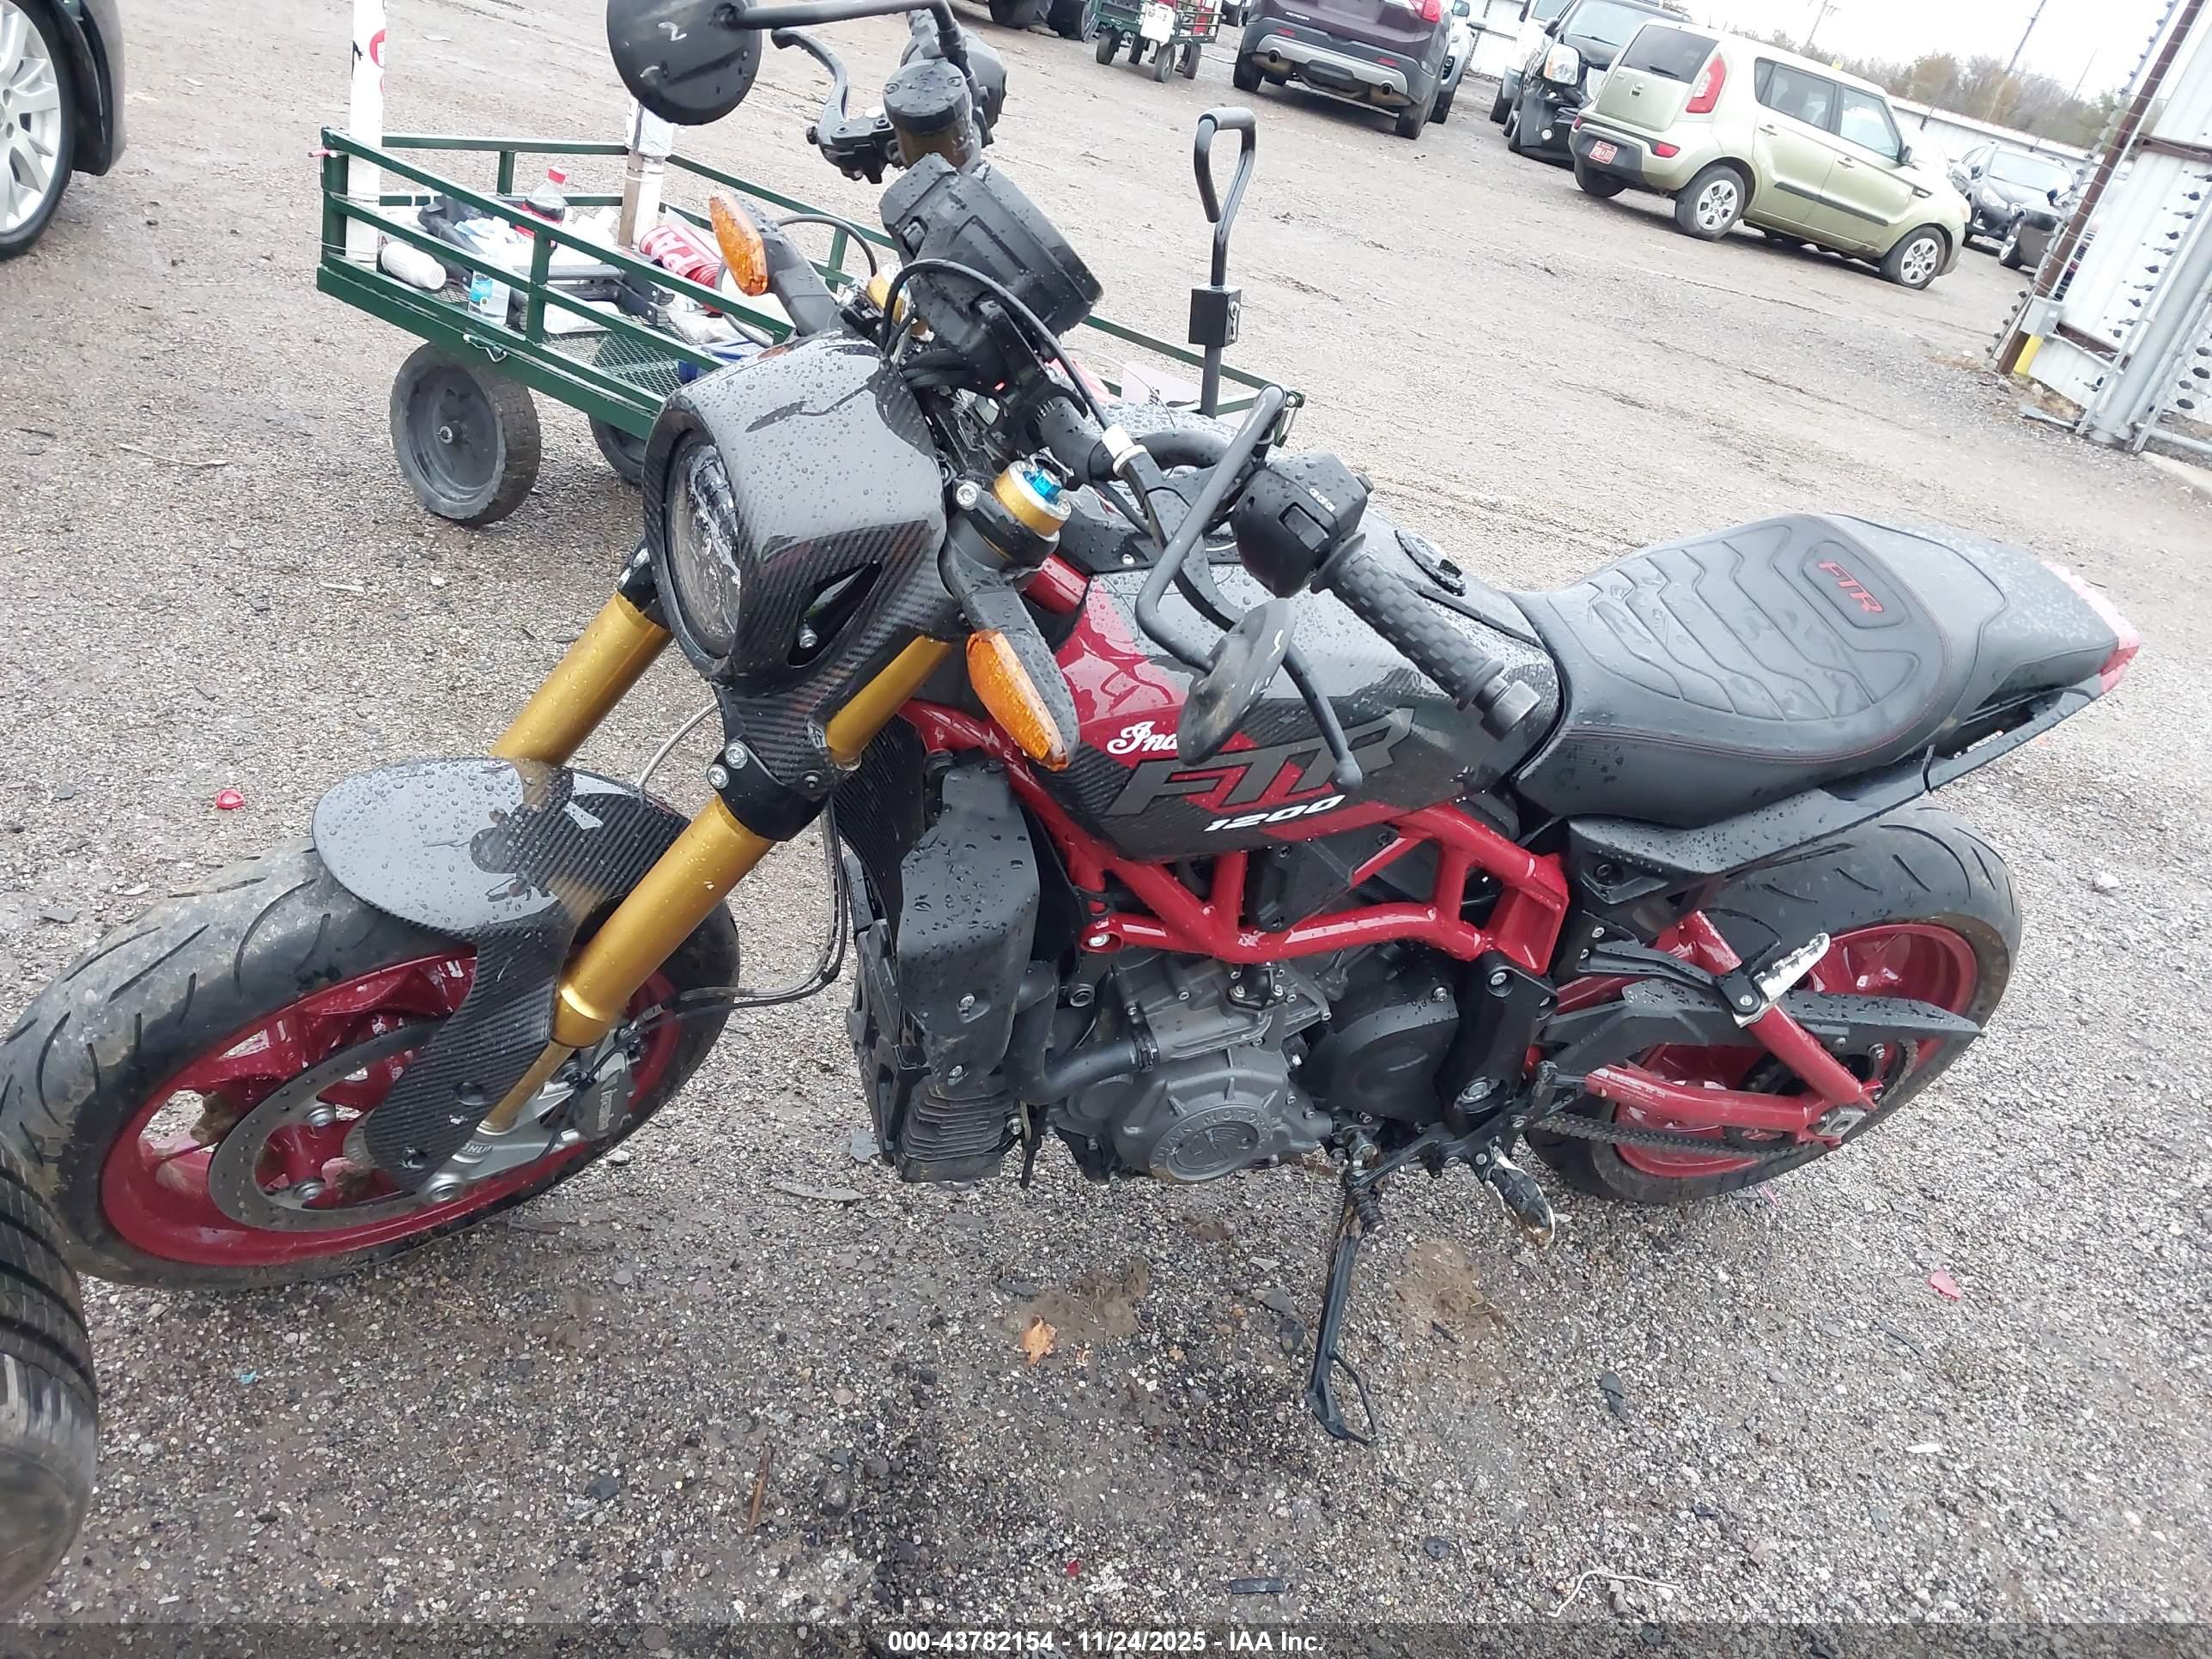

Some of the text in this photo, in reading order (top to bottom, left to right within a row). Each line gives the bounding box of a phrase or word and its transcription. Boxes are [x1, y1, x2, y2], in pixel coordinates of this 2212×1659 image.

[1818, 562, 1883, 612] FTR
[1106, 708, 1414, 816] FTR
[1204, 794, 1346, 832] 1200
